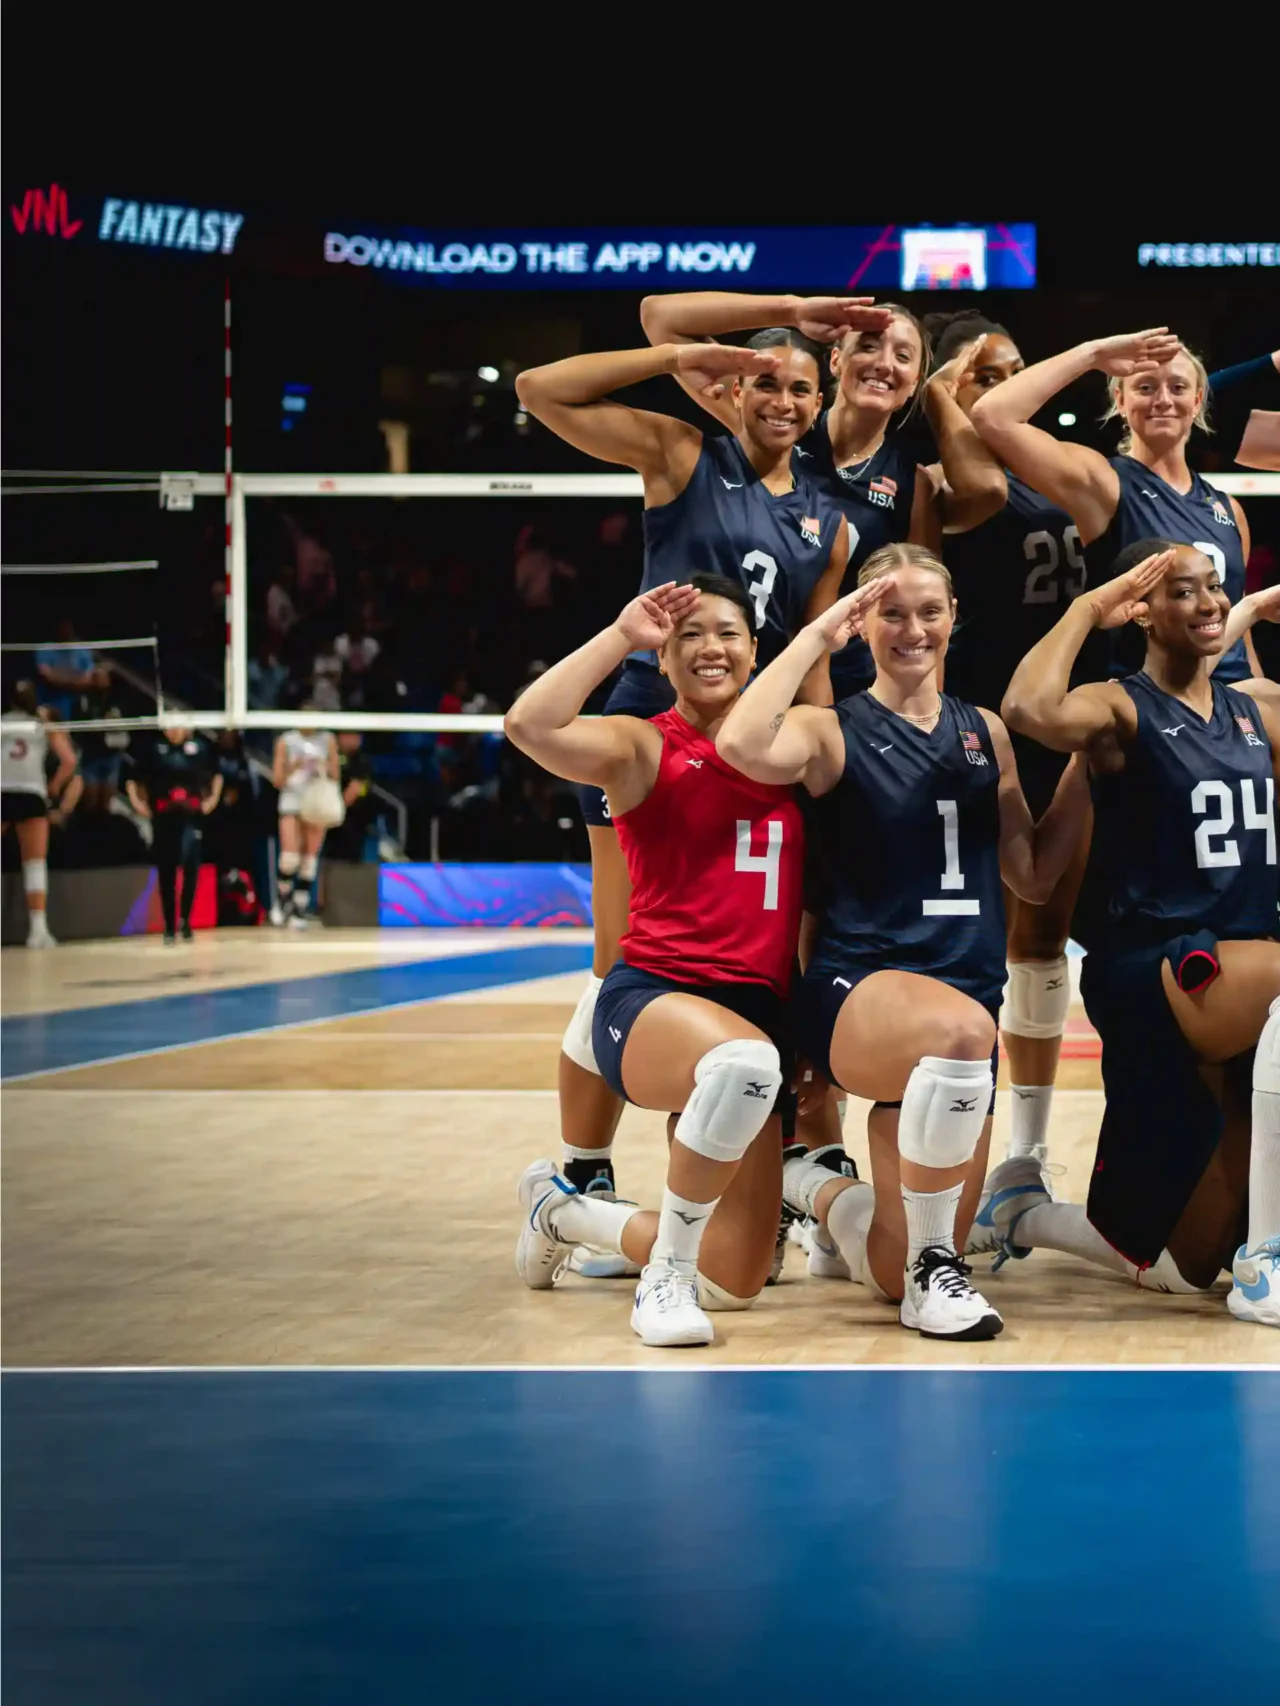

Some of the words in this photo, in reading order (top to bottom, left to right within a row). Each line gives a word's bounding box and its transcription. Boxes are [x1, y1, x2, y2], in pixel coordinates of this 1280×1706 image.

[11, 183, 82, 239] VNL
[99, 197, 244, 254] FANTASY
[324, 232, 516, 273] DOWNLOAD
[519, 242, 588, 272] THE
[593, 243, 661, 272] APP
[667, 242, 756, 272] NOW
[868, 489, 895, 510] USA
[800, 529, 821, 548] USA
[966, 749, 989, 766] USA
[1192, 778, 1277, 868] 24
[735, 820, 783, 910] 4
[936, 800, 965, 890] 1
[609, 1025, 621, 1043] 4
